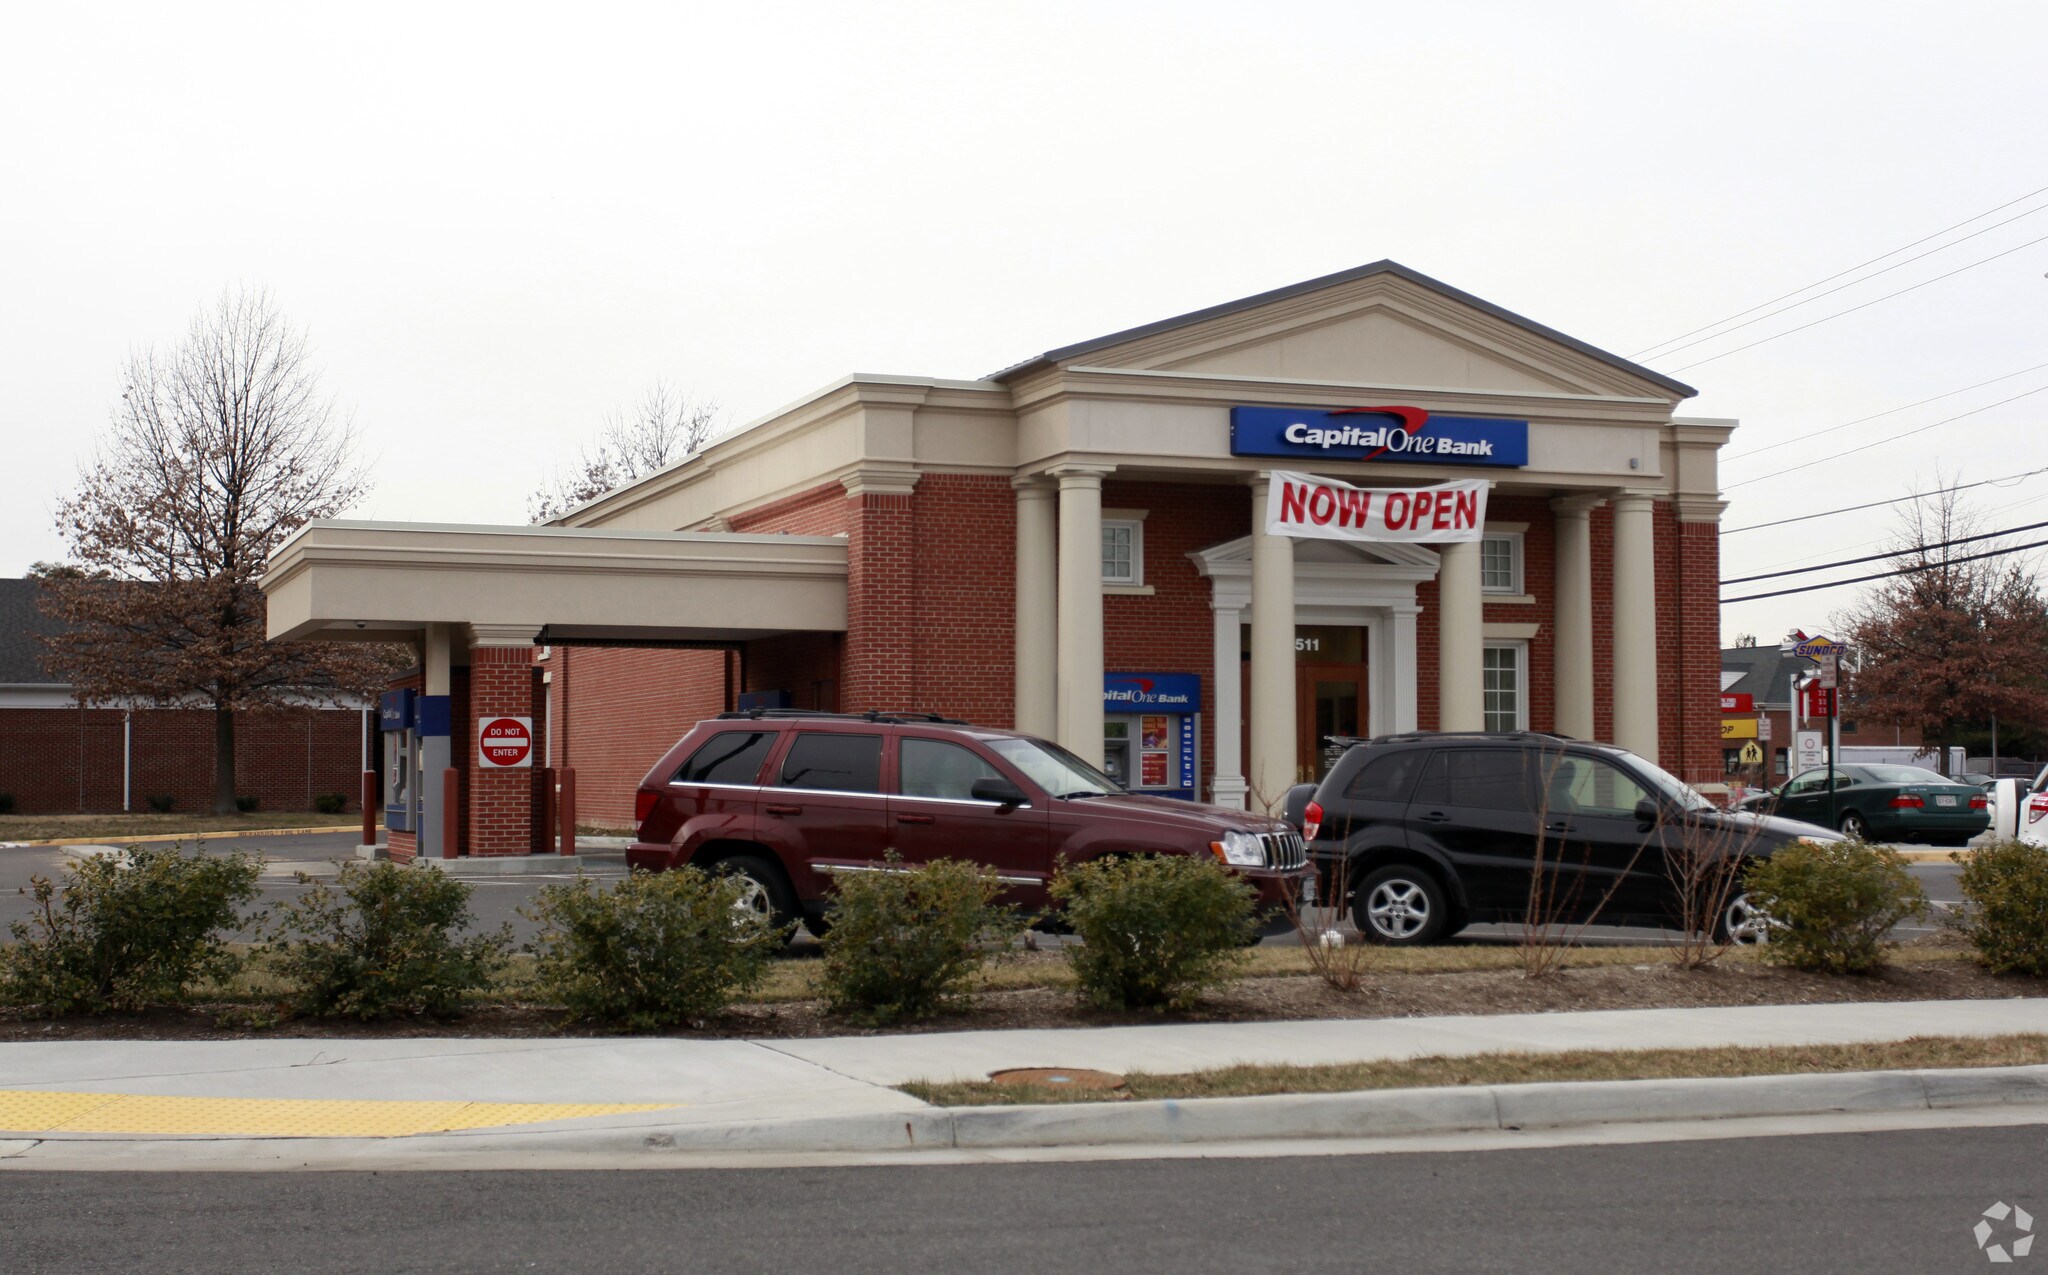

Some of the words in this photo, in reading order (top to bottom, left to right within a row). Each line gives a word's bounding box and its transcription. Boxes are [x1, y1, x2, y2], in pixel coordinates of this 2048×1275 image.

[1437, 438, 1493, 456] Bank
[1280, 481, 1372, 529] NOW
[1384, 490, 1478, 531] OPEN
[1295, 638, 1319, 651] 511
[1798, 645, 1845, 655] SUNOCO
[1158, 694, 1188, 703] Bank
[490, 728, 502, 736] DO
[504, 728, 521, 736] NOT
[493, 748, 519, 757] ENTER
